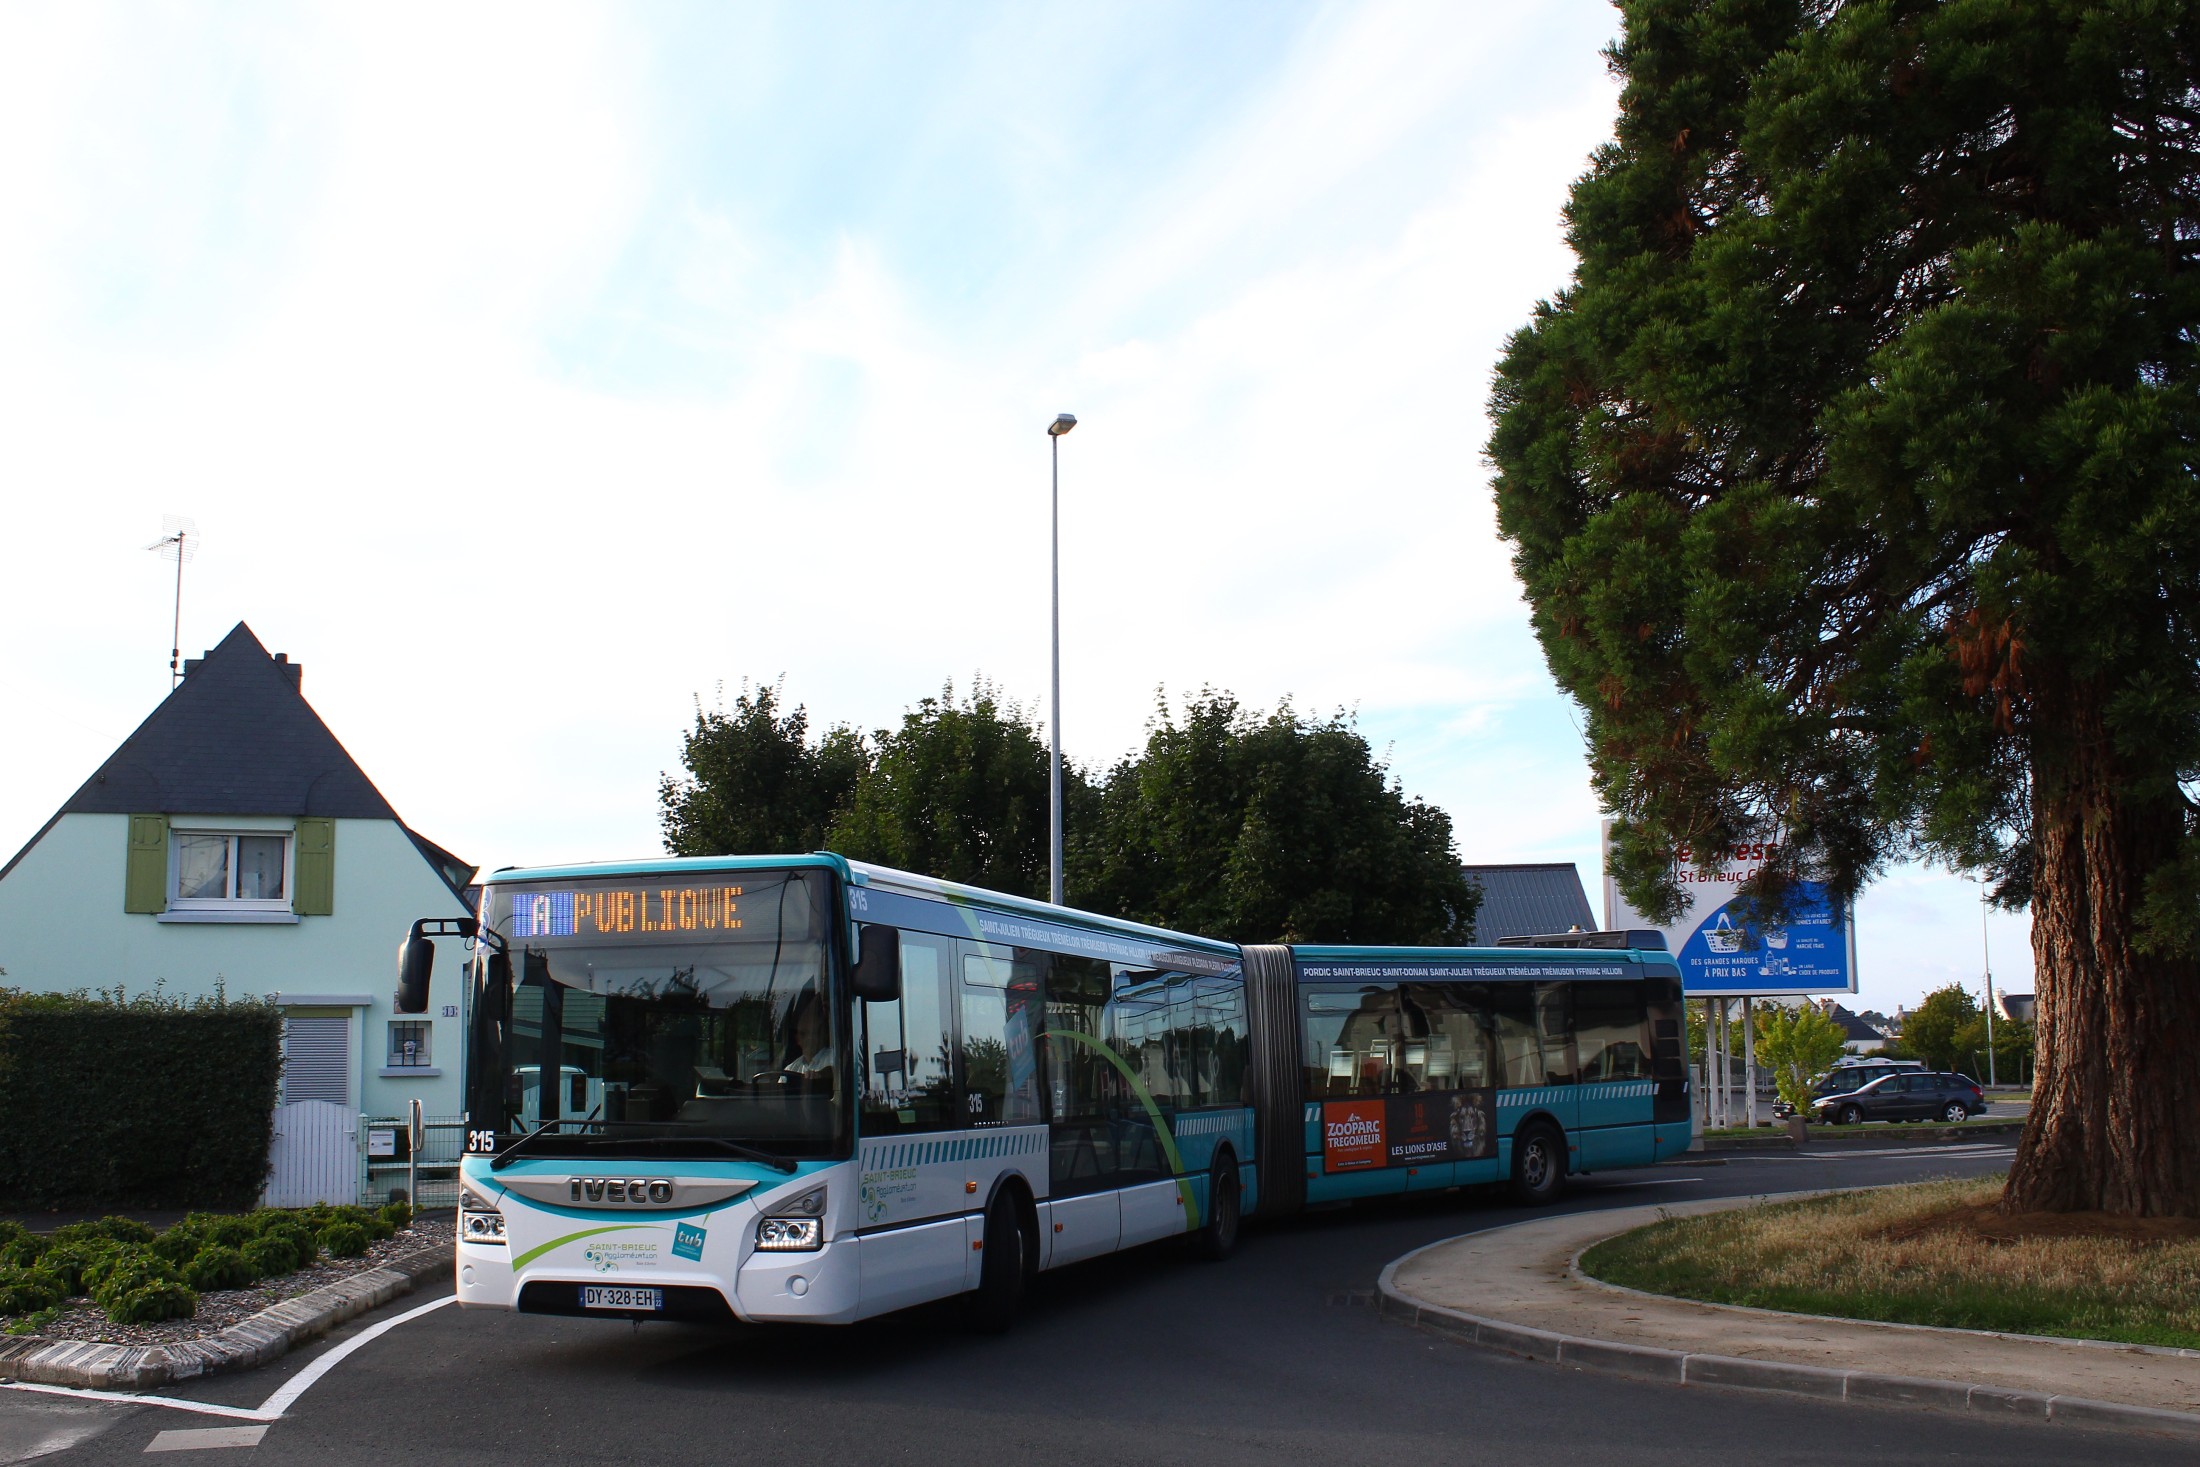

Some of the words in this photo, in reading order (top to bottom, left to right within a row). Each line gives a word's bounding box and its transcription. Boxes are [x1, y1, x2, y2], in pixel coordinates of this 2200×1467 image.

[1678, 842, 1778, 862] eres
[1679, 871, 1694, 883] St
[1697, 870, 1743, 883] Brieuc
[850, 888, 868, 911] 315
[533, 895, 550, 935] A
[573, 886, 742, 933] PUBLIQUE
[979, 919, 1021, 937] SAINT-JULIEN
[1704, 957, 1729, 965] GRANDES
[1303, 968, 1331, 977] PORDIC
[1333, 968, 1381, 977] SAINT-BRIEUC
[1382, 968, 1428, 977] SAINT-DONAN
[1430, 968, 1472, 976] SAINT-JULIEN
[1474, 966, 1506, 976] TRÉGUEUX
[1542, 966, 1574, 976] TRÉMUSON
[1601, 968, 1622, 976] HILLION
[1704, 967, 1710, 977] À
[1712, 968, 1728, 977] PRIX
[1731, 967, 1746, 976] BAS
[968, 1093, 982, 1113] 315
[1327, 1120, 1380, 1137] ZOOPARC
[469, 1130, 494, 1151] 315
[1327, 1133, 1381, 1148] TREGOMEUR
[1391, 1146, 1404, 1156] LES
[1405, 1144, 1425, 1155] LIONS
[1426, 1141, 1447, 1153] D'ASIE
[864, 1168, 917, 1184] SAINT-BRIEUC
[571, 1177, 673, 1204] IVECO
[589, 1243, 657, 1251] SAINT-BRIEUC
[677, 1230, 703, 1248] tub
[587, 1288, 653, 1306] DY-328-EH
[655, 1299, 662, 1307] 22
